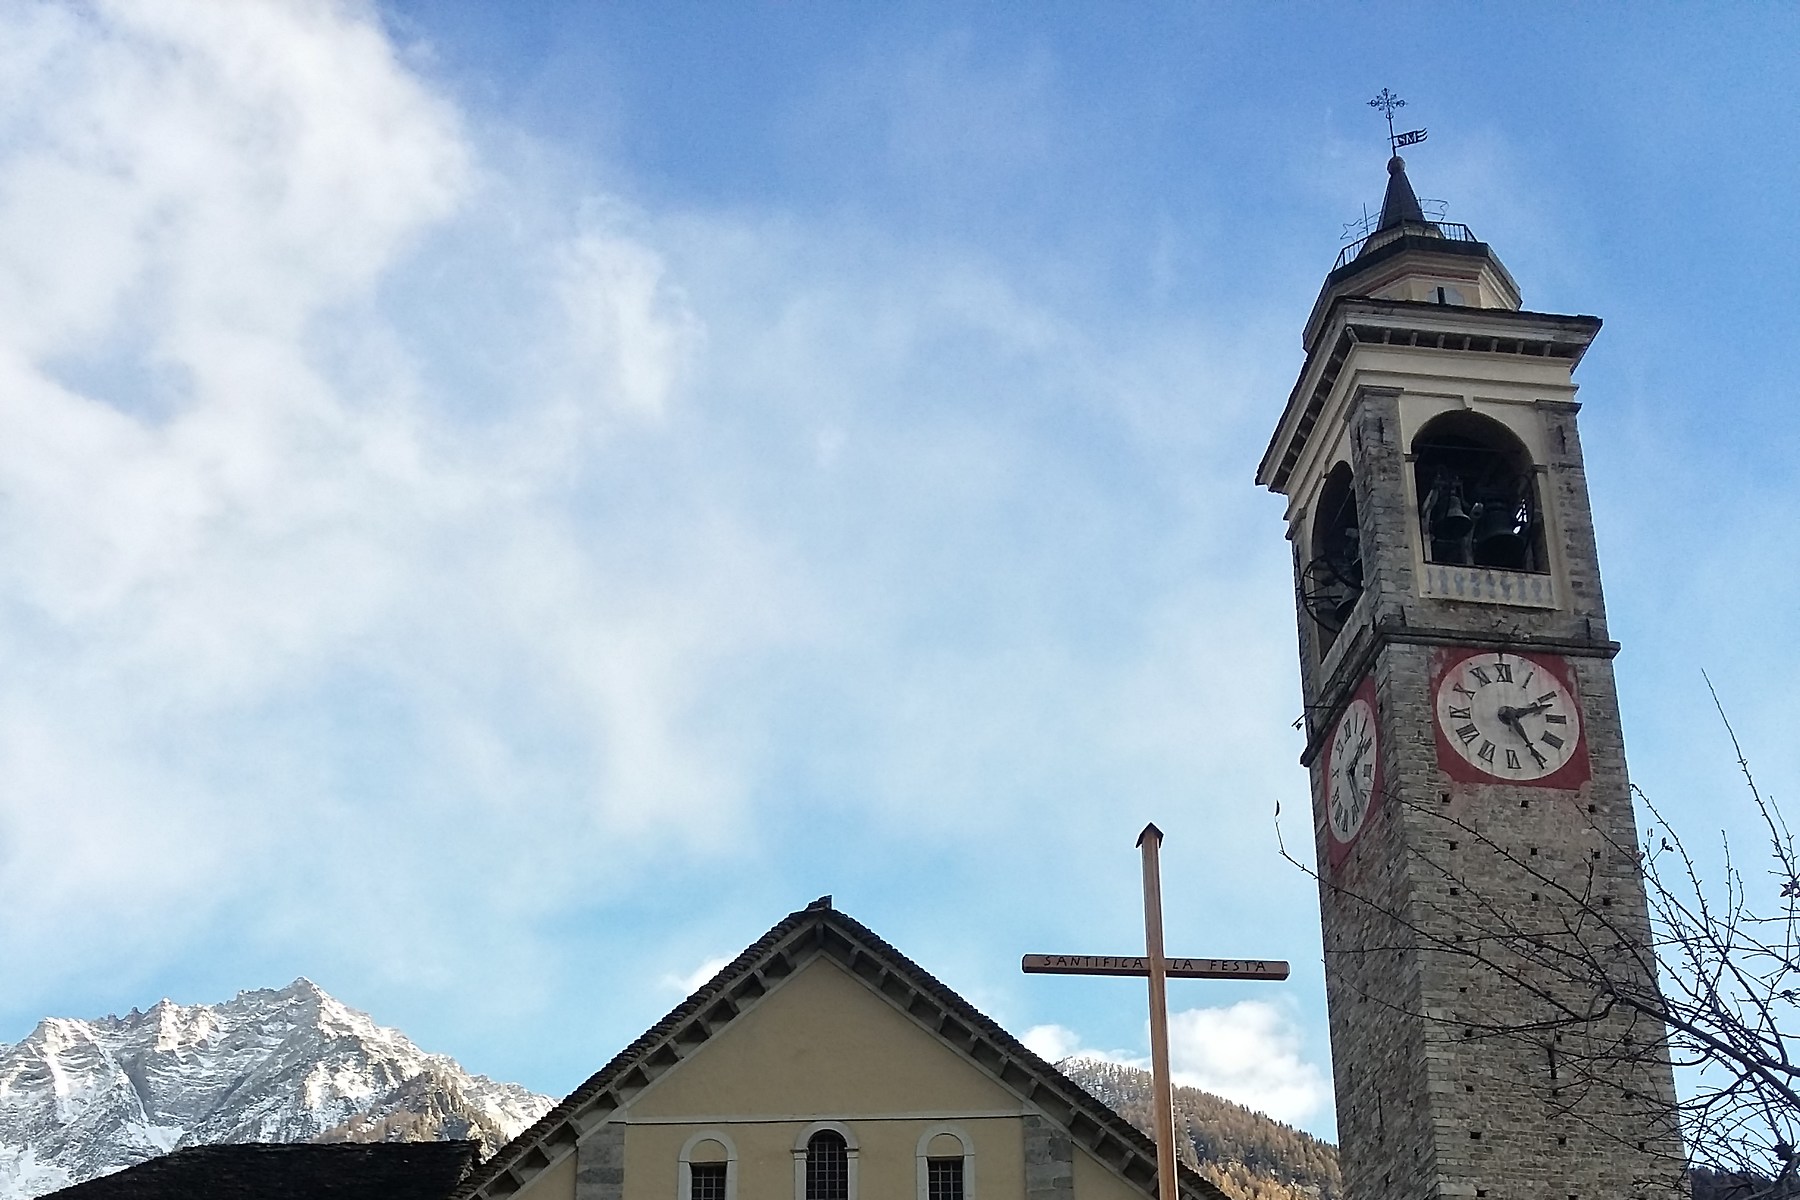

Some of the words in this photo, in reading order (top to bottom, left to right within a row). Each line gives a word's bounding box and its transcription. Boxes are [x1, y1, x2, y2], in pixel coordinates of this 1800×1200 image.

[1494, 663, 1514, 683] XII
[1043, 956, 1144, 969] SANTIFICA
[1172, 959, 1193, 970] LA
[1210, 960, 1266, 972] FESTA
